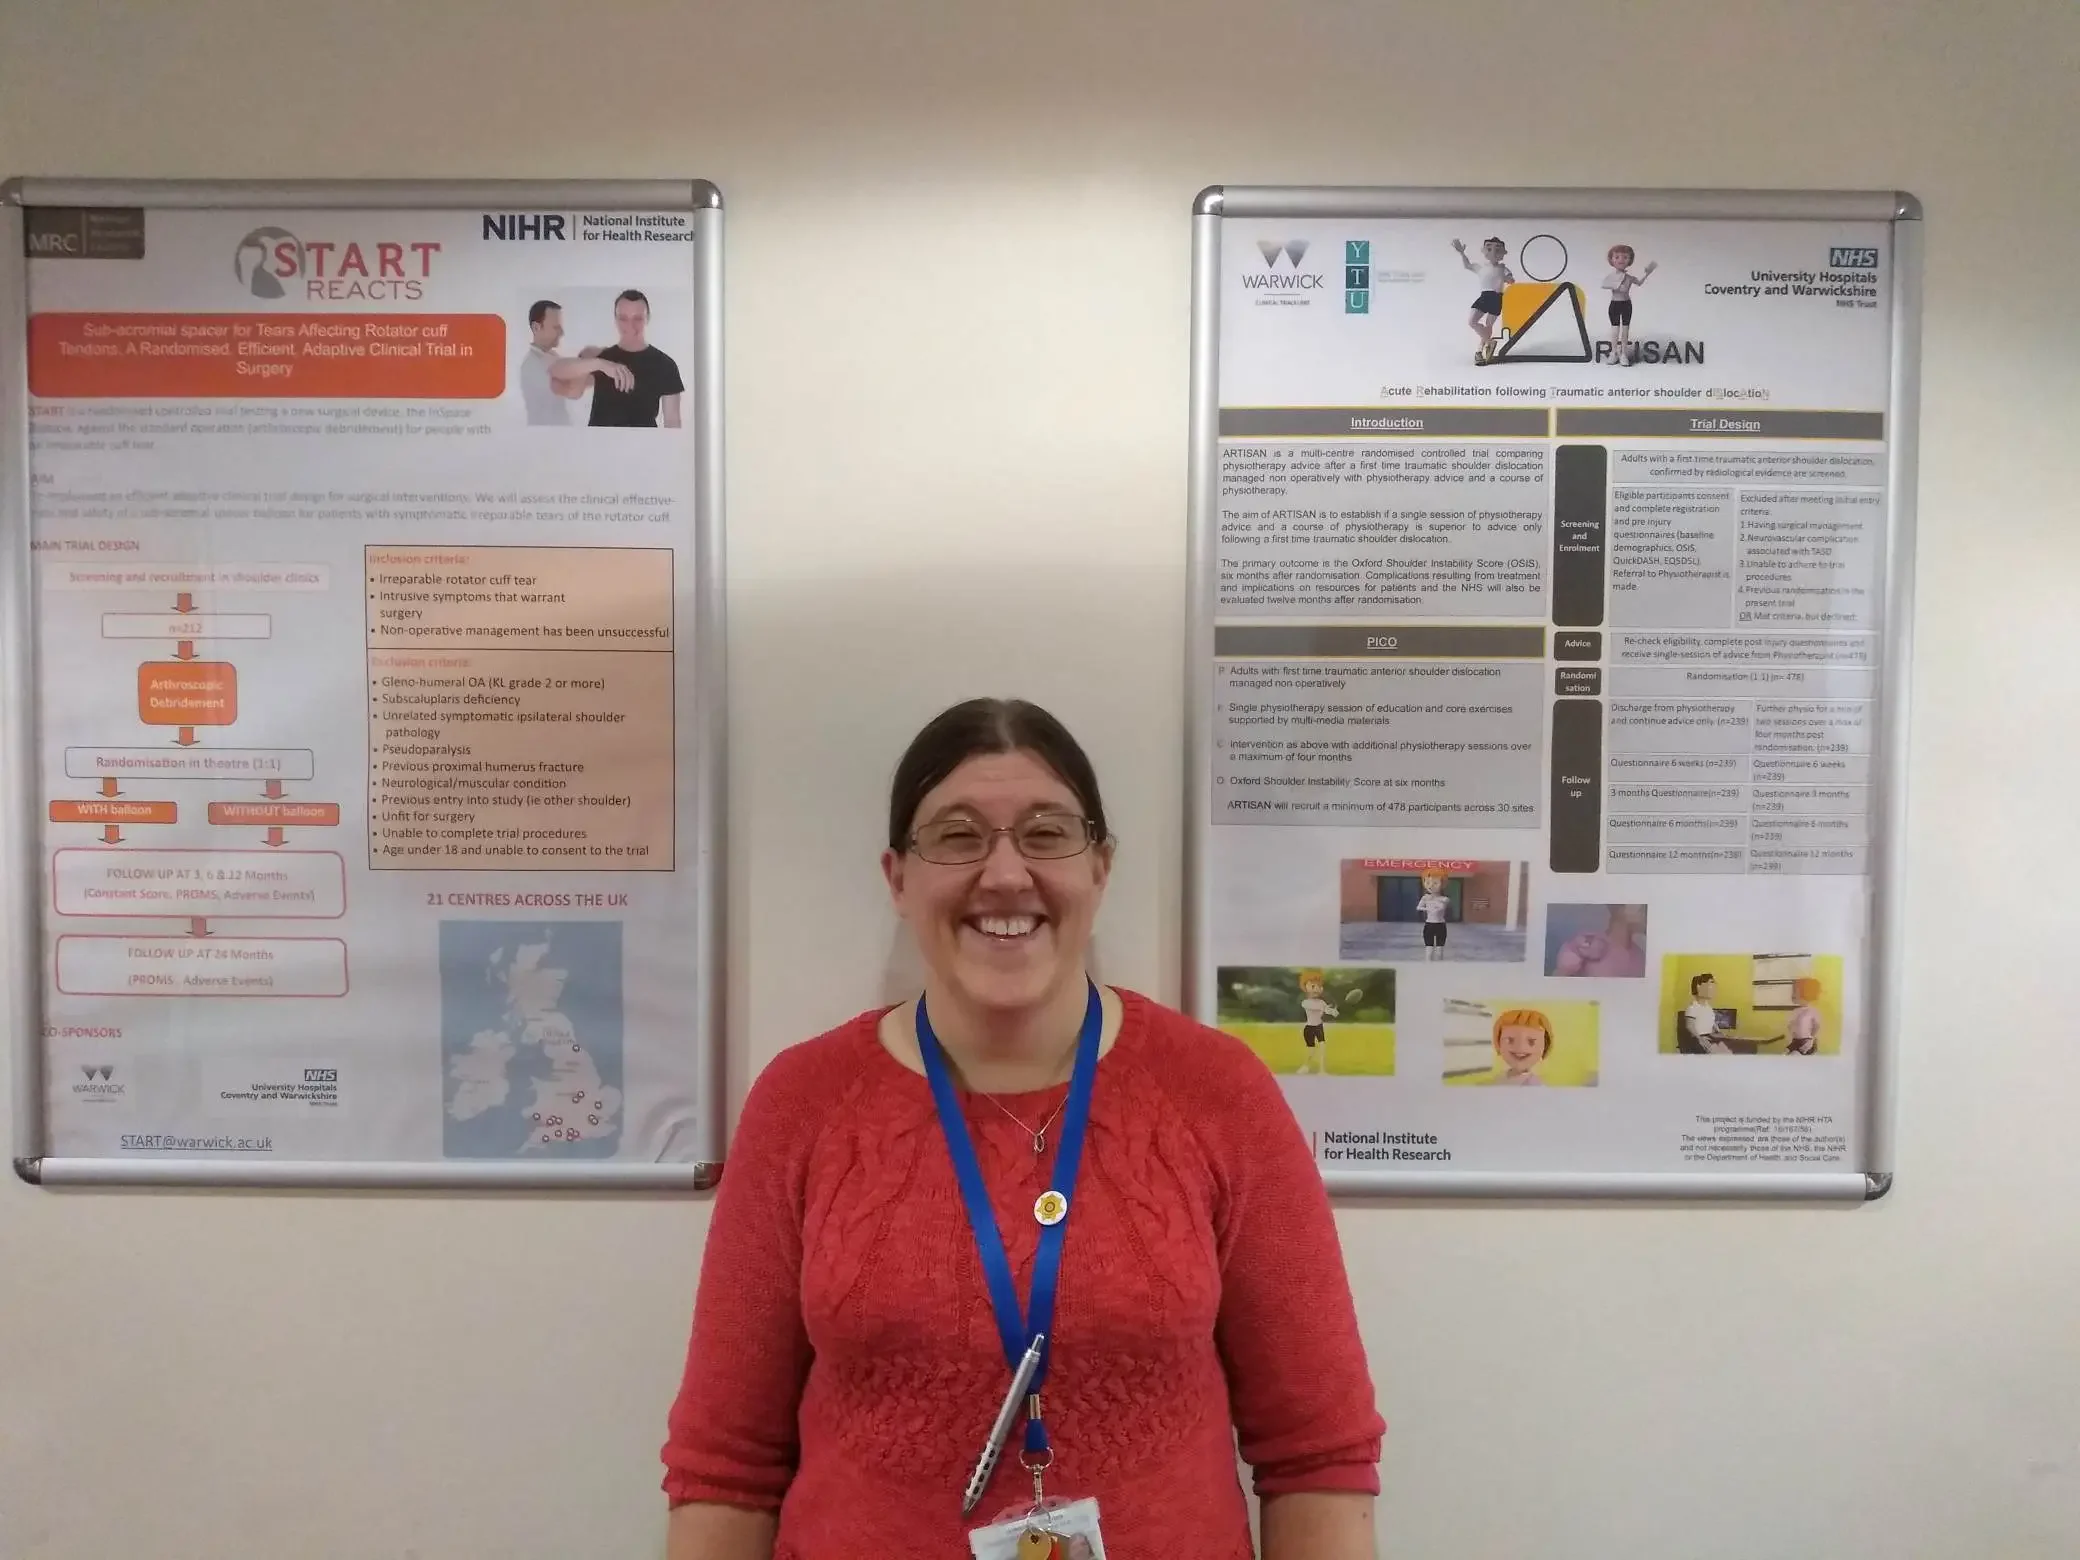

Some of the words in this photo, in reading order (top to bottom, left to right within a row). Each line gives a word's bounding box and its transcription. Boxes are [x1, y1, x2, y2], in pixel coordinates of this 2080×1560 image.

[482, 214, 565, 240] NIHR
[583, 215, 633, 226] National
[634, 216, 685, 227] Institute
[583, 230, 600, 241] for
[602, 230, 643, 241] Health
[30, 234, 78, 252] MRC
[274, 242, 441, 278] START
[1832, 250, 1877, 267] NHS
[1242, 275, 1324, 288] WARWICK
[1751, 271, 1817, 286] University
[1818, 271, 1878, 286] Hospitals
[308, 280, 423, 300] REACTS
[1704, 284, 1762, 299] Coventry
[1763, 284, 1789, 296] and
[1790, 284, 1877, 297] Warwickshire
[83, 324, 178, 337] Sub-acromial
[178, 327, 230, 340] spacer
[232, 324, 253, 337] for
[255, 324, 296, 337] Tears
[297, 324, 361, 340] Affecting
[363, 324, 419, 337] Rotator
[419, 324, 448, 337] cuff
[126, 343, 139, 356] A
[300, 343, 366, 360] Adaptive
[367, 344, 424, 356] Clinical
[424, 344, 456, 356] Trial
[460, 344, 473, 356] in
[236, 361, 294, 378] Surgery
[1494, 387, 1547, 400] following
[1606, 388, 1652, 398] anterior
[1652, 388, 1702, 399] shoulder
[1350, 418, 1424, 428] Introduction
[1690, 419, 1716, 430] Trial
[1719, 419, 1760, 433] Design
[1223, 449, 1269, 458] ARTISAN
[1271, 449, 1282, 458] is
[1299, 449, 1356, 458] multi-centre
[1359, 449, 1416, 458] randomised
[1419, 450, 1468, 458] controlled
[1471, 450, 1491, 458] trial
[1494, 450, 1544, 460] comparing
[1222, 461, 1287, 472] physiotherapy
[1289, 461, 1322, 470] advice
[1322, 461, 1346, 470] after
[1359, 461, 1378, 470] first
[1380, 461, 1401, 470] time
[1403, 461, 1448, 470] traumatic
[1449, 462, 1493, 470] shoulder
[1493, 462, 1544, 470] dislocation
[1560, 520, 1600, 530] Screening
[1571, 532, 1587, 540] and
[1559, 544, 1600, 552] Enrolment
[379, 574, 443, 587] Irreparable
[445, 575, 487, 585] rotator
[488, 575, 512, 585] cuff
[512, 575, 537, 585] tear
[379, 591, 430, 602] Intrusive
[431, 592, 493, 605] symptoms
[493, 592, 518, 602] that
[519, 592, 566, 603] warrant
[379, 610, 423, 621] surgery
[380, 626, 463, 639] Non-operative
[465, 626, 541, 639] management
[541, 627, 562, 637] has
[565, 627, 596, 637] been
[596, 627, 669, 638] unsuccessful
[1367, 637, 1398, 647] PICO
[1564, 640, 1592, 648] Advice
[1230, 667, 1260, 676] Adults
[1260, 667, 1280, 676] with
[1282, 667, 1301, 676] first
[1301, 667, 1322, 676] time
[1324, 668, 1368, 676] traumatic
[1368, 668, 1406, 676] anterior
[1406, 668, 1450, 676] shoulder
[1450, 668, 1501, 676] dislocation
[150, 680, 224, 693] Arthroscopic
[1229, 679, 1273, 690] managed
[1294, 679, 1346, 690] operatively
[150, 698, 224, 708] Debridement
[382, 712, 437, 721] Unrelated
[439, 712, 514, 724] symptomatic
[516, 712, 573, 725] ipsilateral
[574, 712, 626, 722] shoulder
[385, 727, 441, 740] pathology
[382, 745, 472, 757] Pseudoparalysis
[96, 758, 188, 768] Randomisation
[188, 758, 200, 768] in
[203, 758, 250, 769] theatre
[251, 759, 281, 771] (1:1)
[382, 762, 430, 772] Previous
[430, 762, 483, 774] proximal
[484, 762, 537, 772] humerus
[537, 762, 584, 772] fracture
[382, 778, 511, 791] Neurological/muscular
[511, 778, 567, 788] condition
[1562, 776, 1591, 785] Follow
[1570, 790, 1582, 799] up
[78, 805, 108, 815] WITH
[108, 805, 152, 815] balloon
[223, 806, 281, 816] WITHOUT
[282, 806, 325, 816] balloon
[1227, 801, 1272, 810] ARTISAN
[1272, 802, 1289, 810] will
[1290, 802, 1321, 810] recruit
[1330, 802, 1374, 811] minimum
[1375, 803, 1386, 811] of
[1386, 803, 1406, 811] 478
[1406, 803, 1463, 814] participants
[1496, 804, 1510, 812] 30
[382, 812, 411, 822] Unfit
[412, 812, 430, 822] for
[431, 814, 475, 824] surgery
[382, 829, 424, 838] Unable
[425, 829, 439, 838] to
[439, 829, 494, 841] complete
[496, 829, 520, 839] trial
[520, 829, 587, 841] procedures
[1364, 859, 1473, 869] EMERGENCY
[427, 894, 444, 905] 21
[447, 894, 513, 905] CENTRES
[513, 894, 571, 906] ACROSS
[574, 894, 605, 906] THE
[606, 895, 628, 906] UK
[305, 1070, 337, 1081] NHS
[72, 1084, 125, 1093] WARWICK
[252, 1084, 296, 1094] University
[296, 1084, 337, 1094] Hospitals
[220, 1092, 259, 1102] Coventry
[260, 1092, 278, 1100] and
[279, 1092, 338, 1100] Warwickshire
[1324, 1132, 1380, 1144] National
[1382, 1132, 1438, 1144] Institute
[1324, 1149, 1344, 1160] for
[1345, 1149, 1391, 1160] Health
[1391, 1149, 1451, 1160] Research
